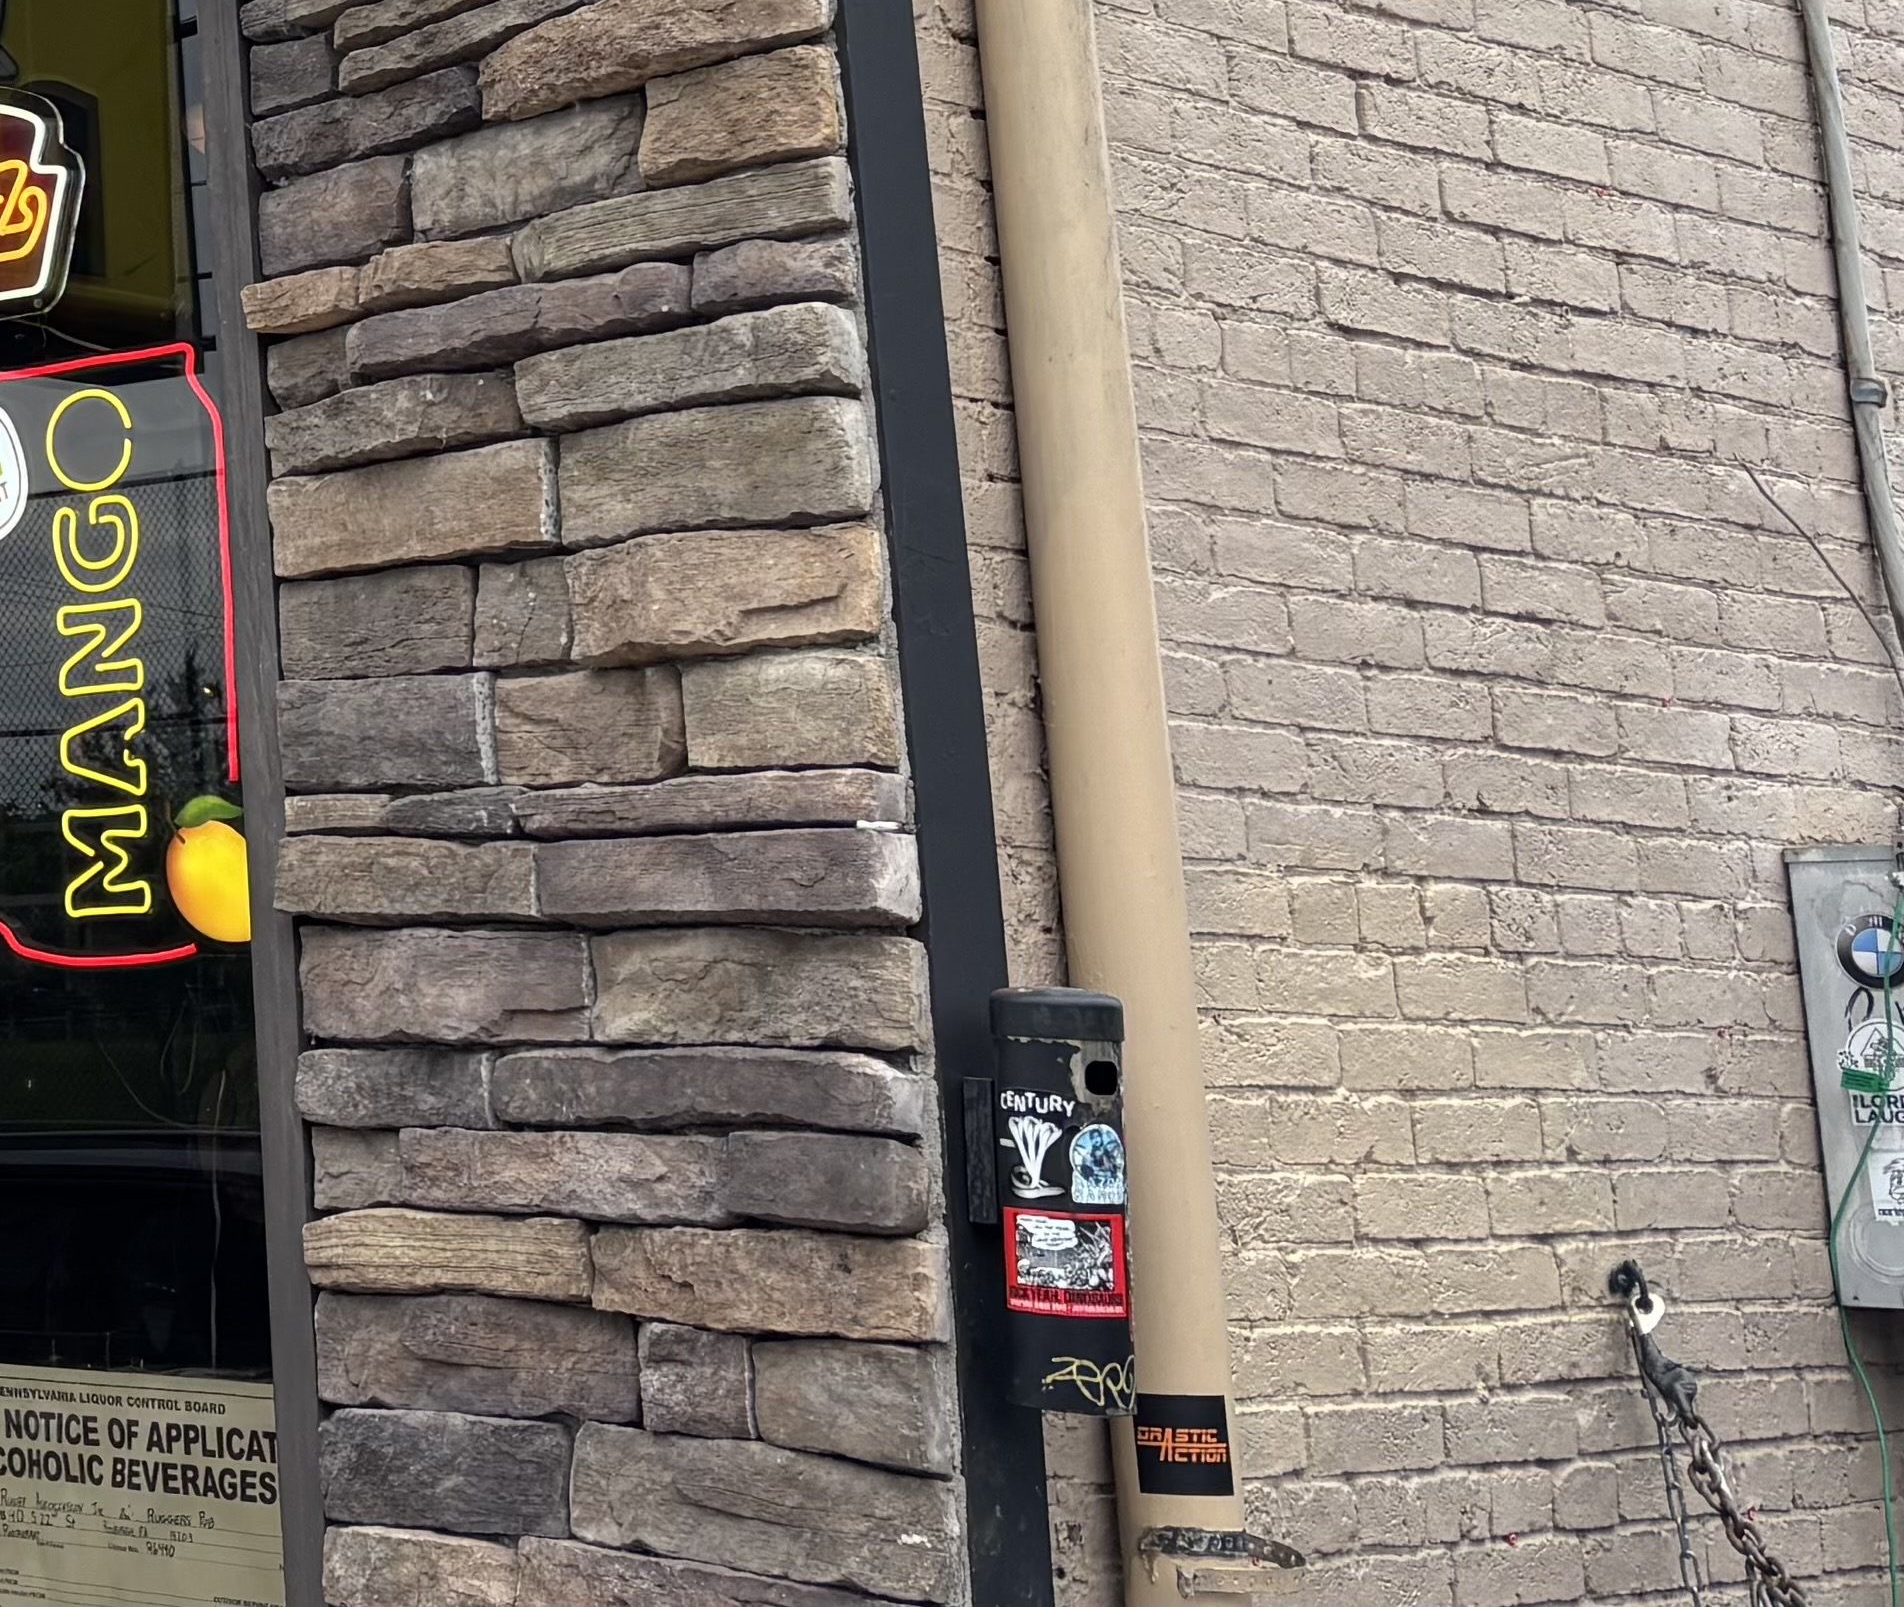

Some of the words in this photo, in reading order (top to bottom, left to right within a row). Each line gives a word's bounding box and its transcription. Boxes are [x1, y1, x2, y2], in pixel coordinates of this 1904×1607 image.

[45, 387, 153, 919] MANGO
[1000, 1090, 1076, 1118] CENTURY
[79, 1392, 123, 1407] LIQUOR
[127, 1396, 181, 1411] CONTROL
[184, 1401, 226, 1415] BOARD
[4, 1408, 100, 1447] NOTICE
[108, 1417, 139, 1450] OF
[111, 1457, 278, 1505] BEVERAGES
